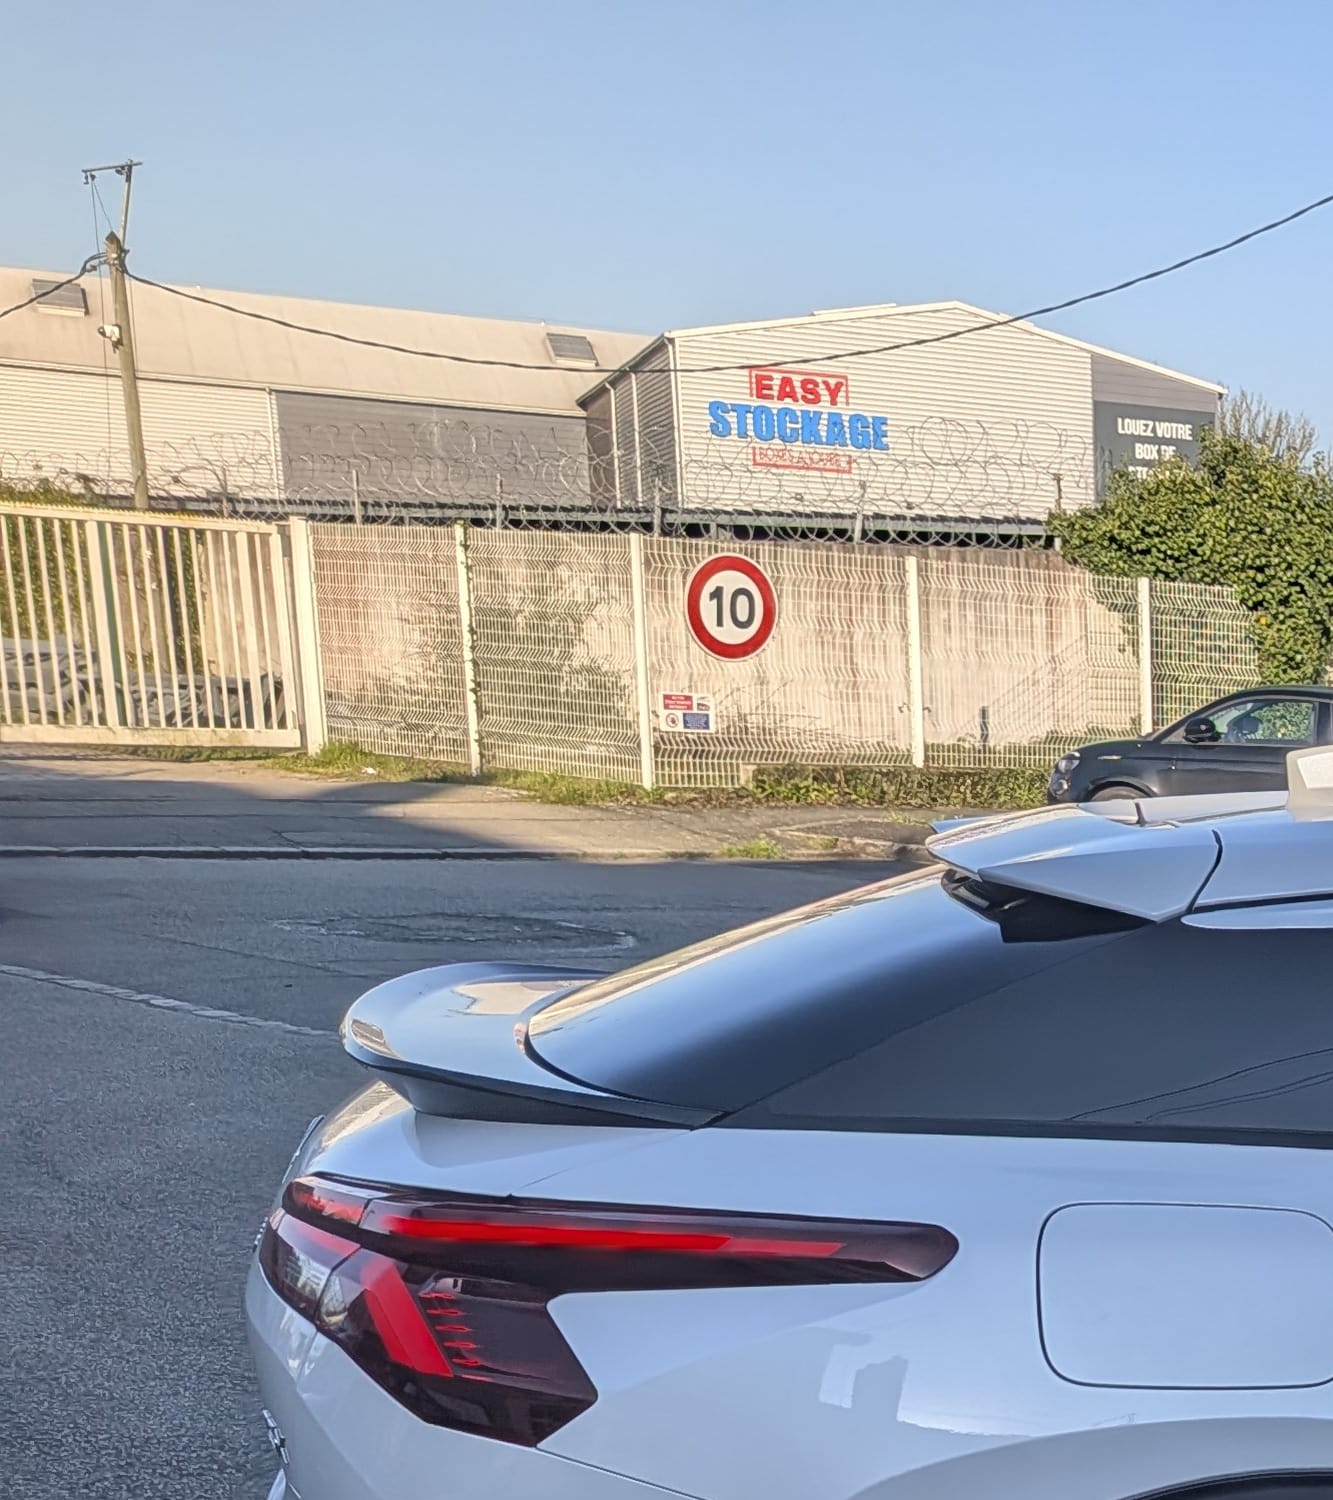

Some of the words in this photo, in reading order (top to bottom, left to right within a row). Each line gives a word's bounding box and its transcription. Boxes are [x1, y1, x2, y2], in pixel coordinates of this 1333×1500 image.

[755, 374, 844, 406] EASY
[708, 400, 890, 451] STOCKAGE
[1117, 417, 1154, 437] LOUEZ
[1156, 421, 1193, 441] VOTRE
[1135, 442, 1159, 460] BOX
[709, 586, 756, 629] 10
